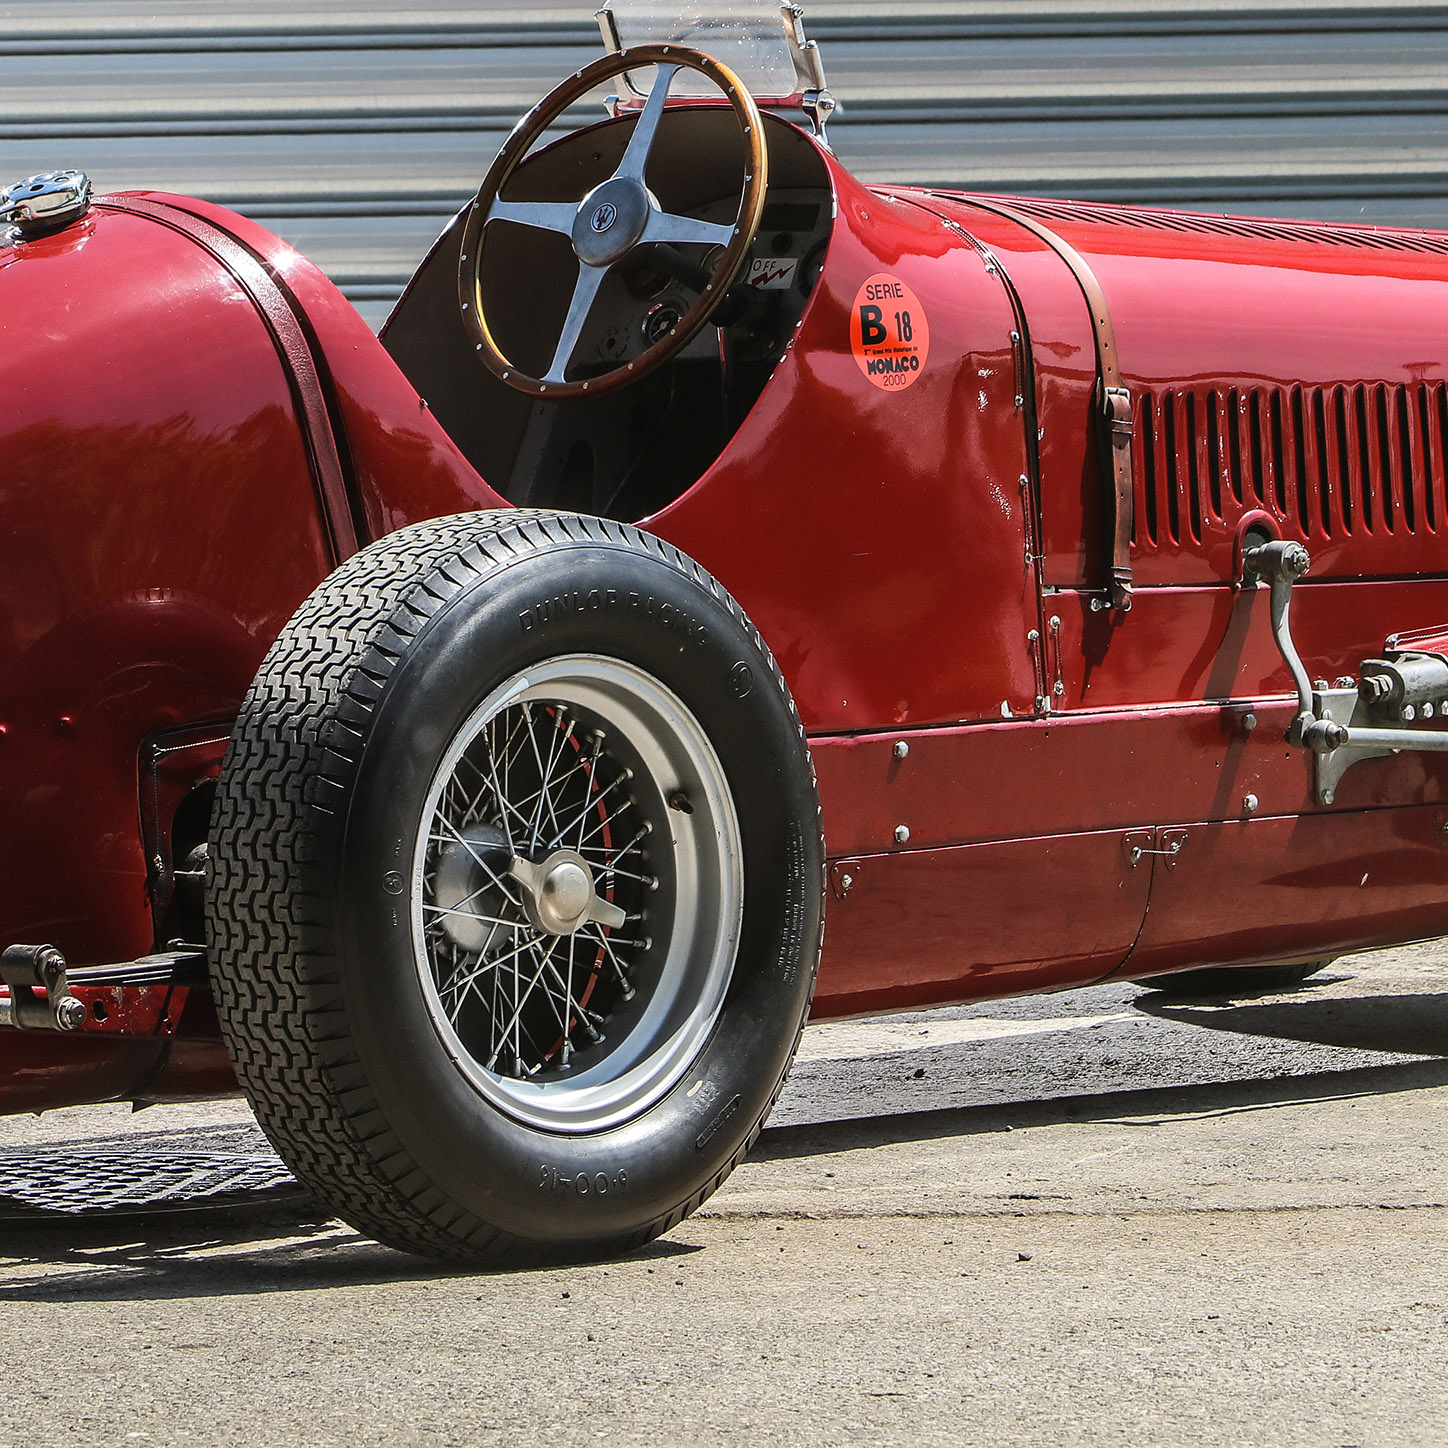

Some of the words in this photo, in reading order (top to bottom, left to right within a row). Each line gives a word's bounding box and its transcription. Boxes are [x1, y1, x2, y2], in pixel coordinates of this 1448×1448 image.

[752, 259, 777, 272] OFF
[866, 283, 904, 300] SERIE
[859, 304, 887, 346] B
[894, 310, 913, 342] 18
[866, 355, 920, 375] MONACO
[883, 373, 907, 387] 2000
[518, 589, 618, 633] DUNLOP
[626, 590, 711, 647] RACING
